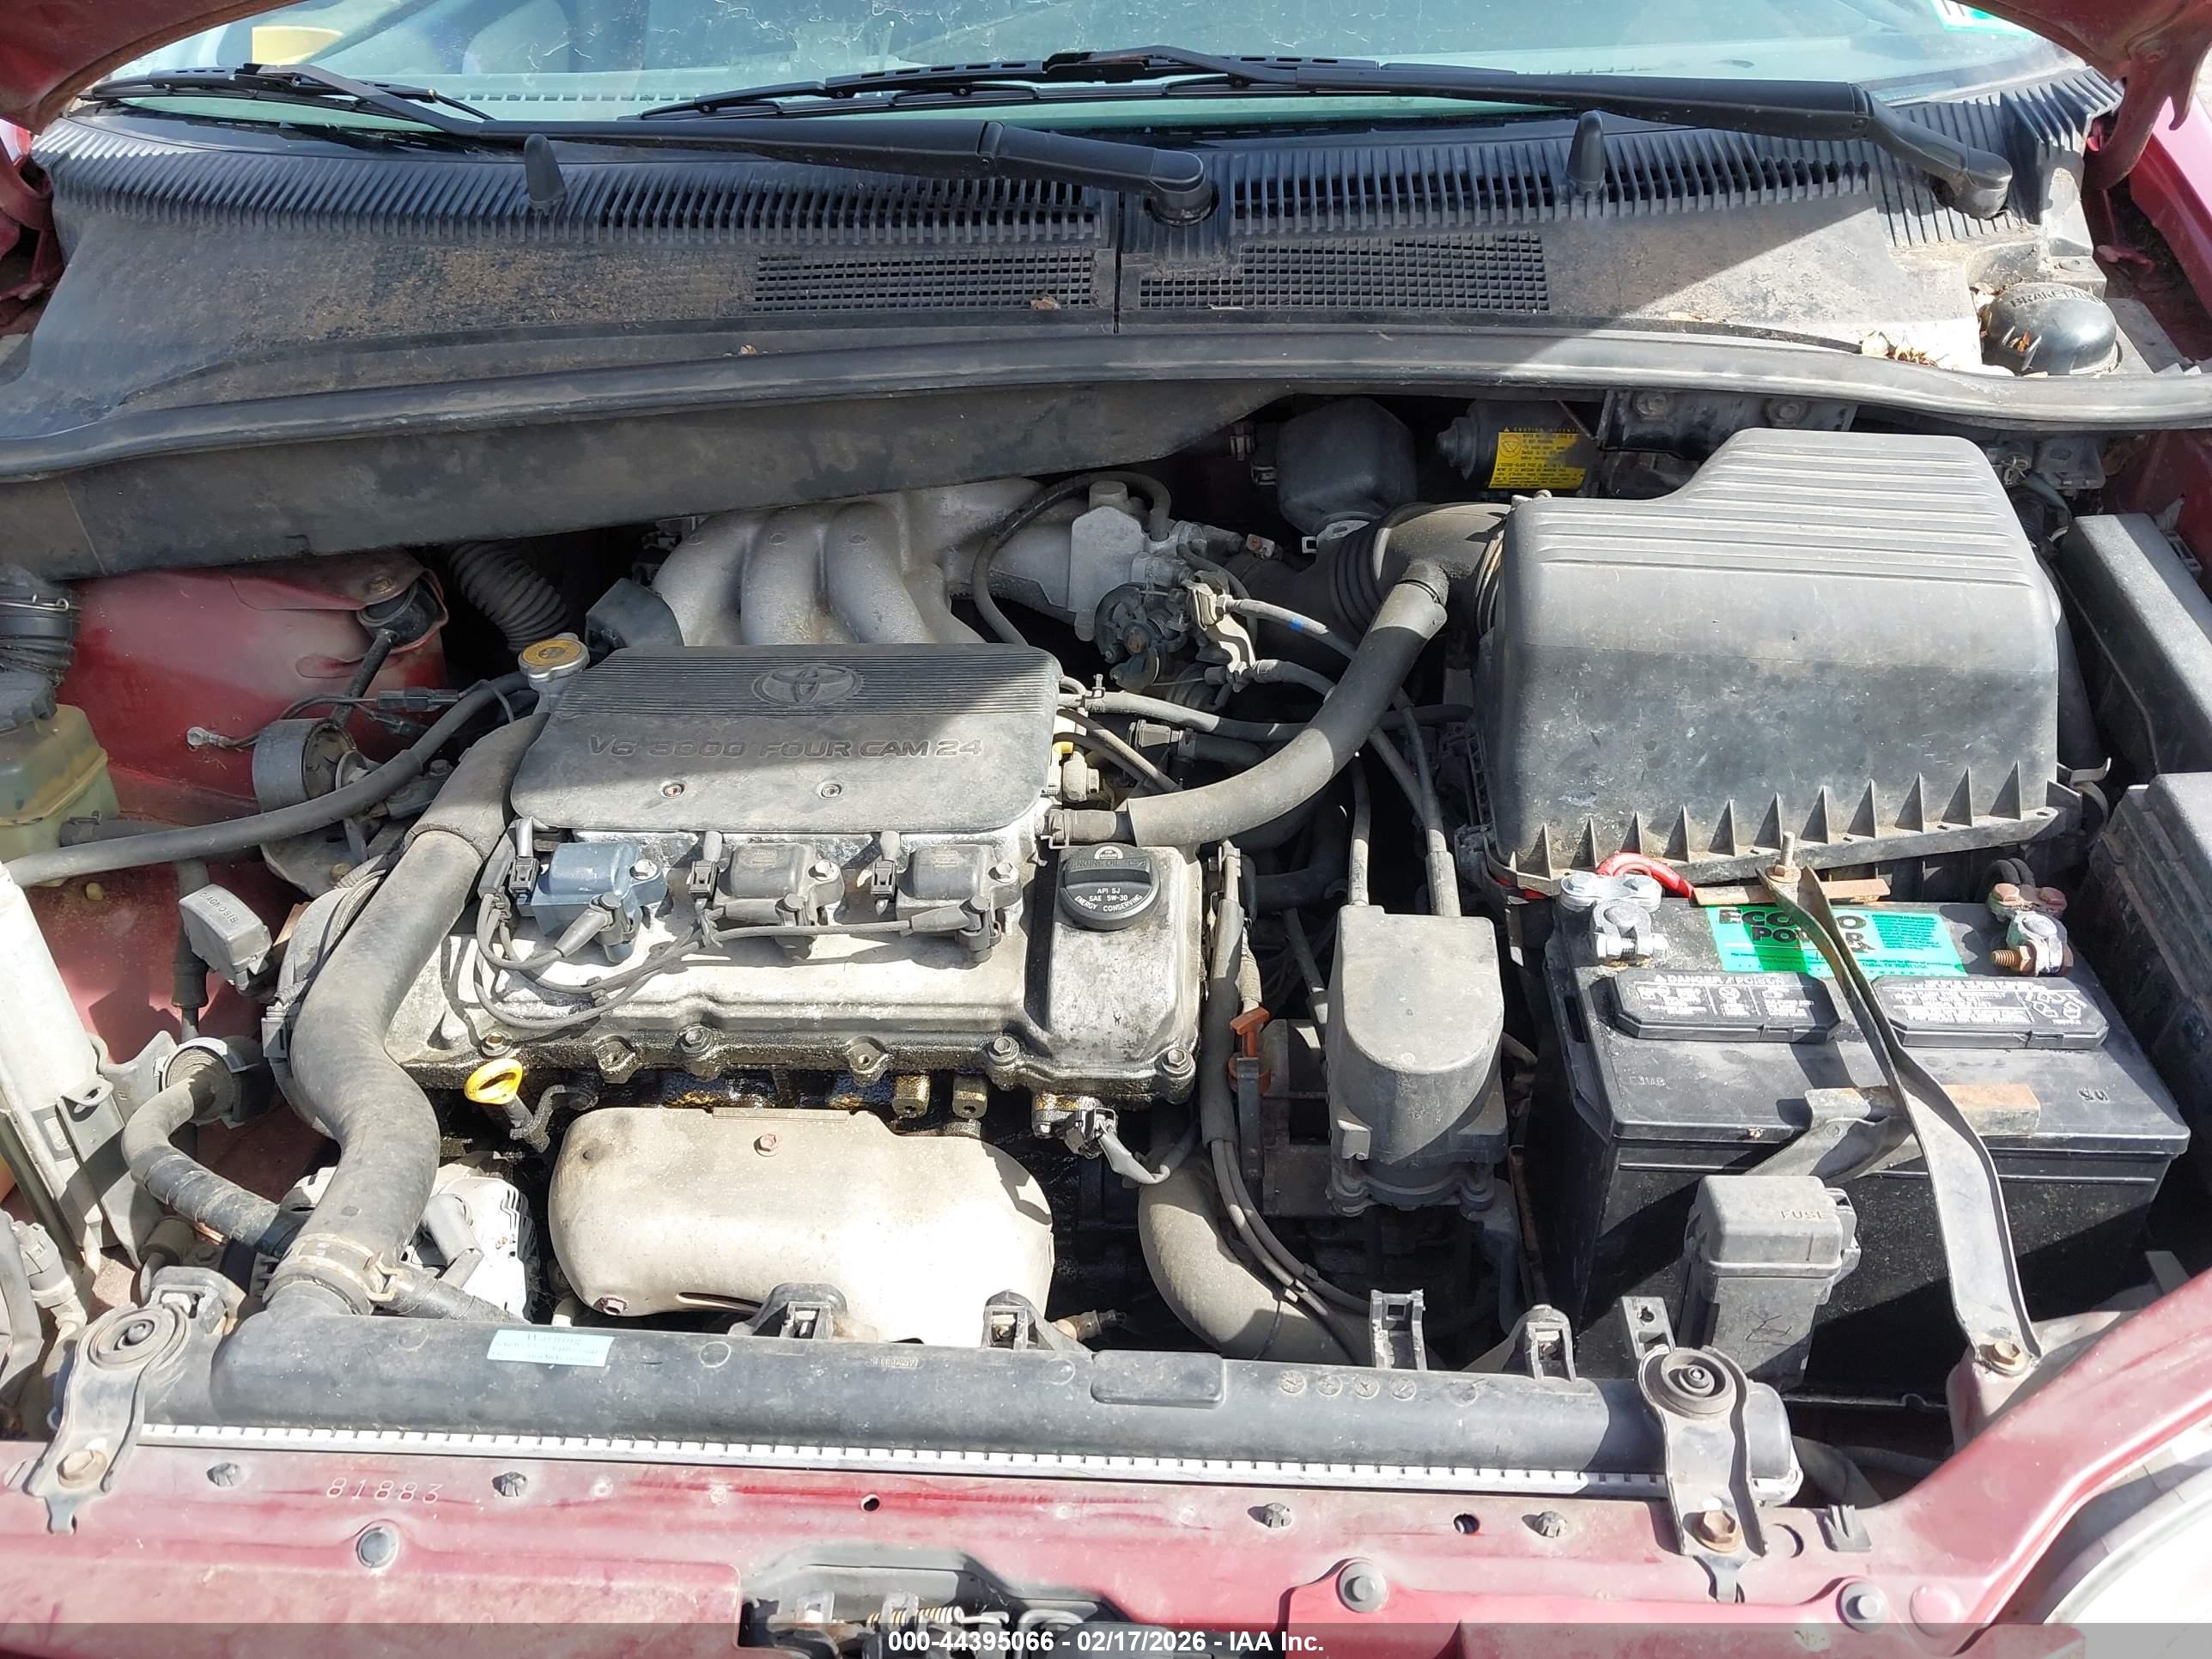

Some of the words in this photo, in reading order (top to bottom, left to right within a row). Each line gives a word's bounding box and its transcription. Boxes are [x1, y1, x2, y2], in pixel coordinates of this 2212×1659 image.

[2009, 289, 2061, 307] BRAKE
[590, 733, 640, 757] V6
[647, 740, 748, 757] 3000
[759, 740, 852, 758] FOUR
[860, 739, 930, 757] CAM
[934, 738, 982, 757] 24
[1074, 895, 1098, 910] ENERGY
[1103, 894, 1143, 912] CONSERVING
[1718, 908, 1867, 929] ECOO
[1780, 1210, 1827, 1219] FUSE
[326, 1477, 445, 1504] 81883
